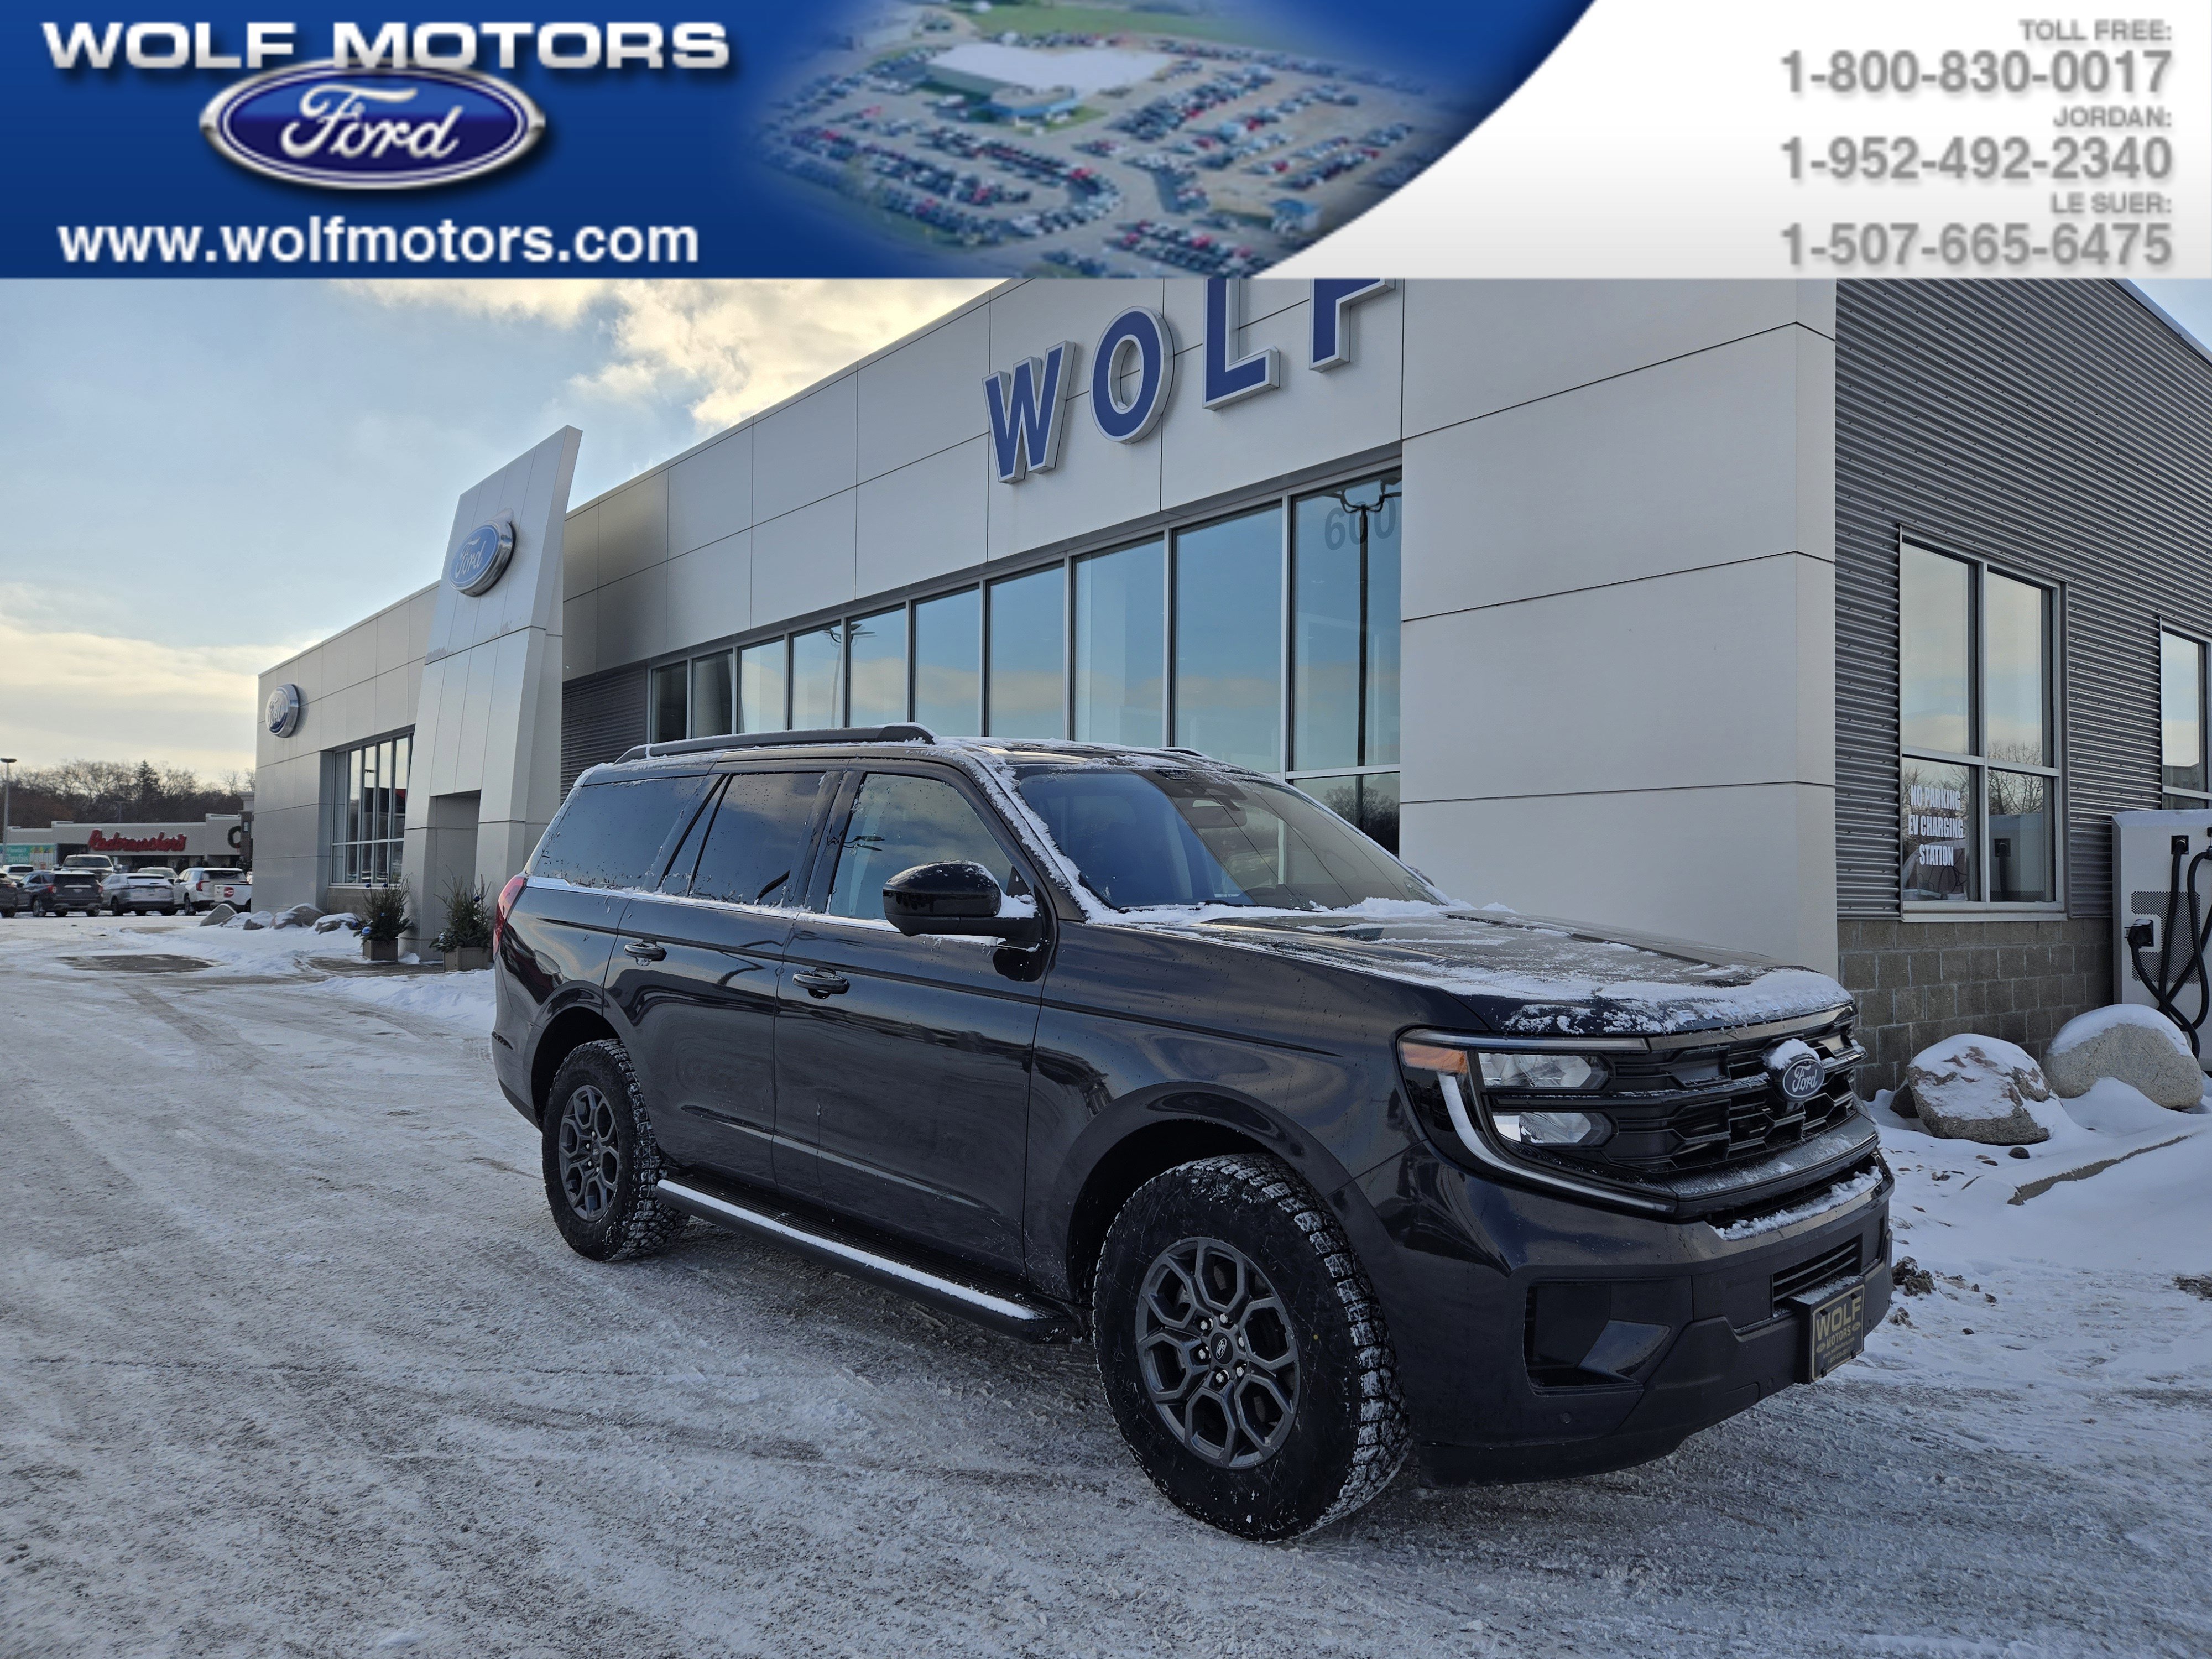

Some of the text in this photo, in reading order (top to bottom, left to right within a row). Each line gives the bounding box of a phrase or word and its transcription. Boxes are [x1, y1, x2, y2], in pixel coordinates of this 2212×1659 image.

[1325, 497, 1396, 551] 600
[455, 536, 487, 579] Ford
[1911, 785, 1961, 811] NO PARKING
[1908, 815, 1964, 839] EV CHARGING
[1919, 844, 1954, 866] STATION
[1792, 1065, 1818, 1093] Ford
[1817, 1296, 1862, 1341] WOLF
[1826, 1325, 1851, 1349] MOTORS
